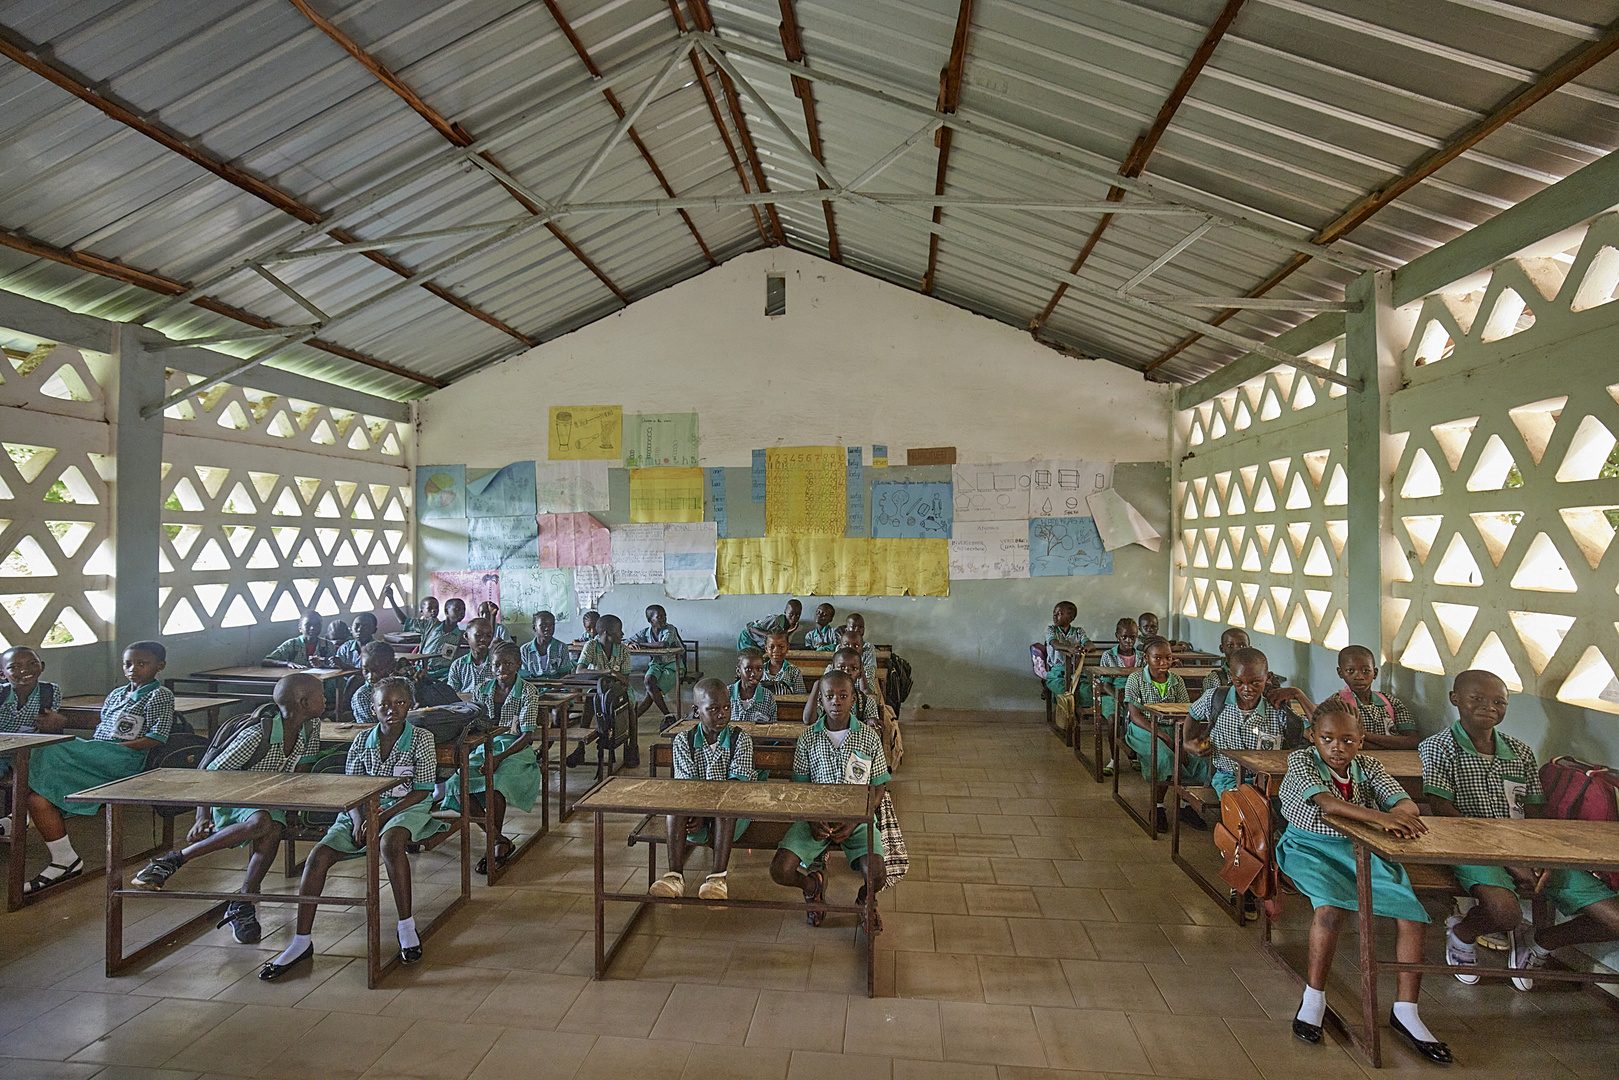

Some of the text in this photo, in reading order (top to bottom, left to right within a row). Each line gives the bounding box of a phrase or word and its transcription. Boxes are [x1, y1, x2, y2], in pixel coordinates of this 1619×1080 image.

[775, 454, 780, 462] 2
[783, 454, 788, 462] 3
[790, 454, 796, 462] 4
[798, 454, 804, 462] 5
[806, 454, 812, 462] 6
[696, 523, 714, 531] FLAG
